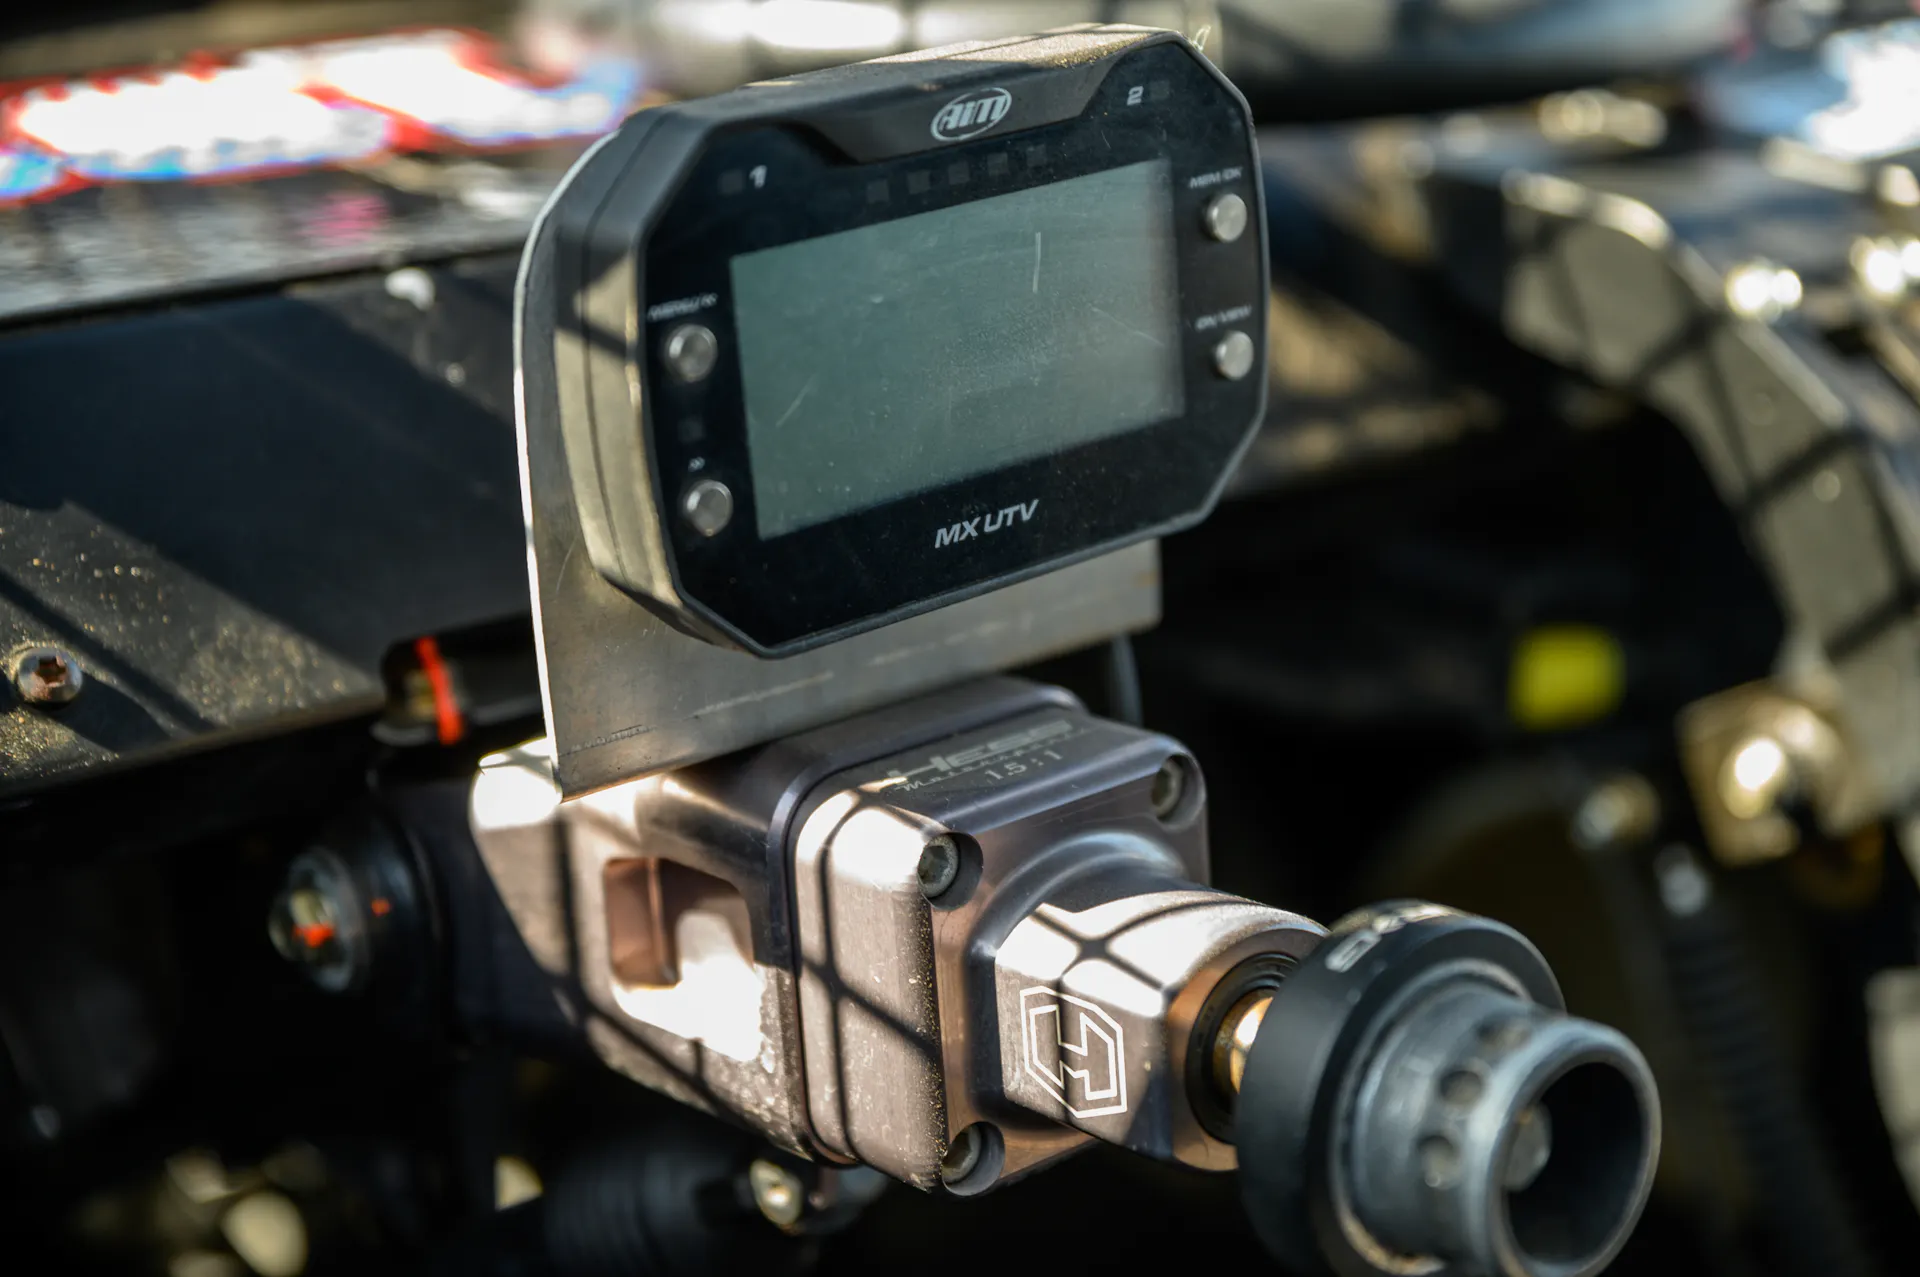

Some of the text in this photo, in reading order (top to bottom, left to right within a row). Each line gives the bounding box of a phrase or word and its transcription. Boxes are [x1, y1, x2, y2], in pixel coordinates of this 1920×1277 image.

[1126, 86, 1144, 106] 2
[749, 164, 767, 189] 1
[935, 499, 1039, 549] MX UTV
